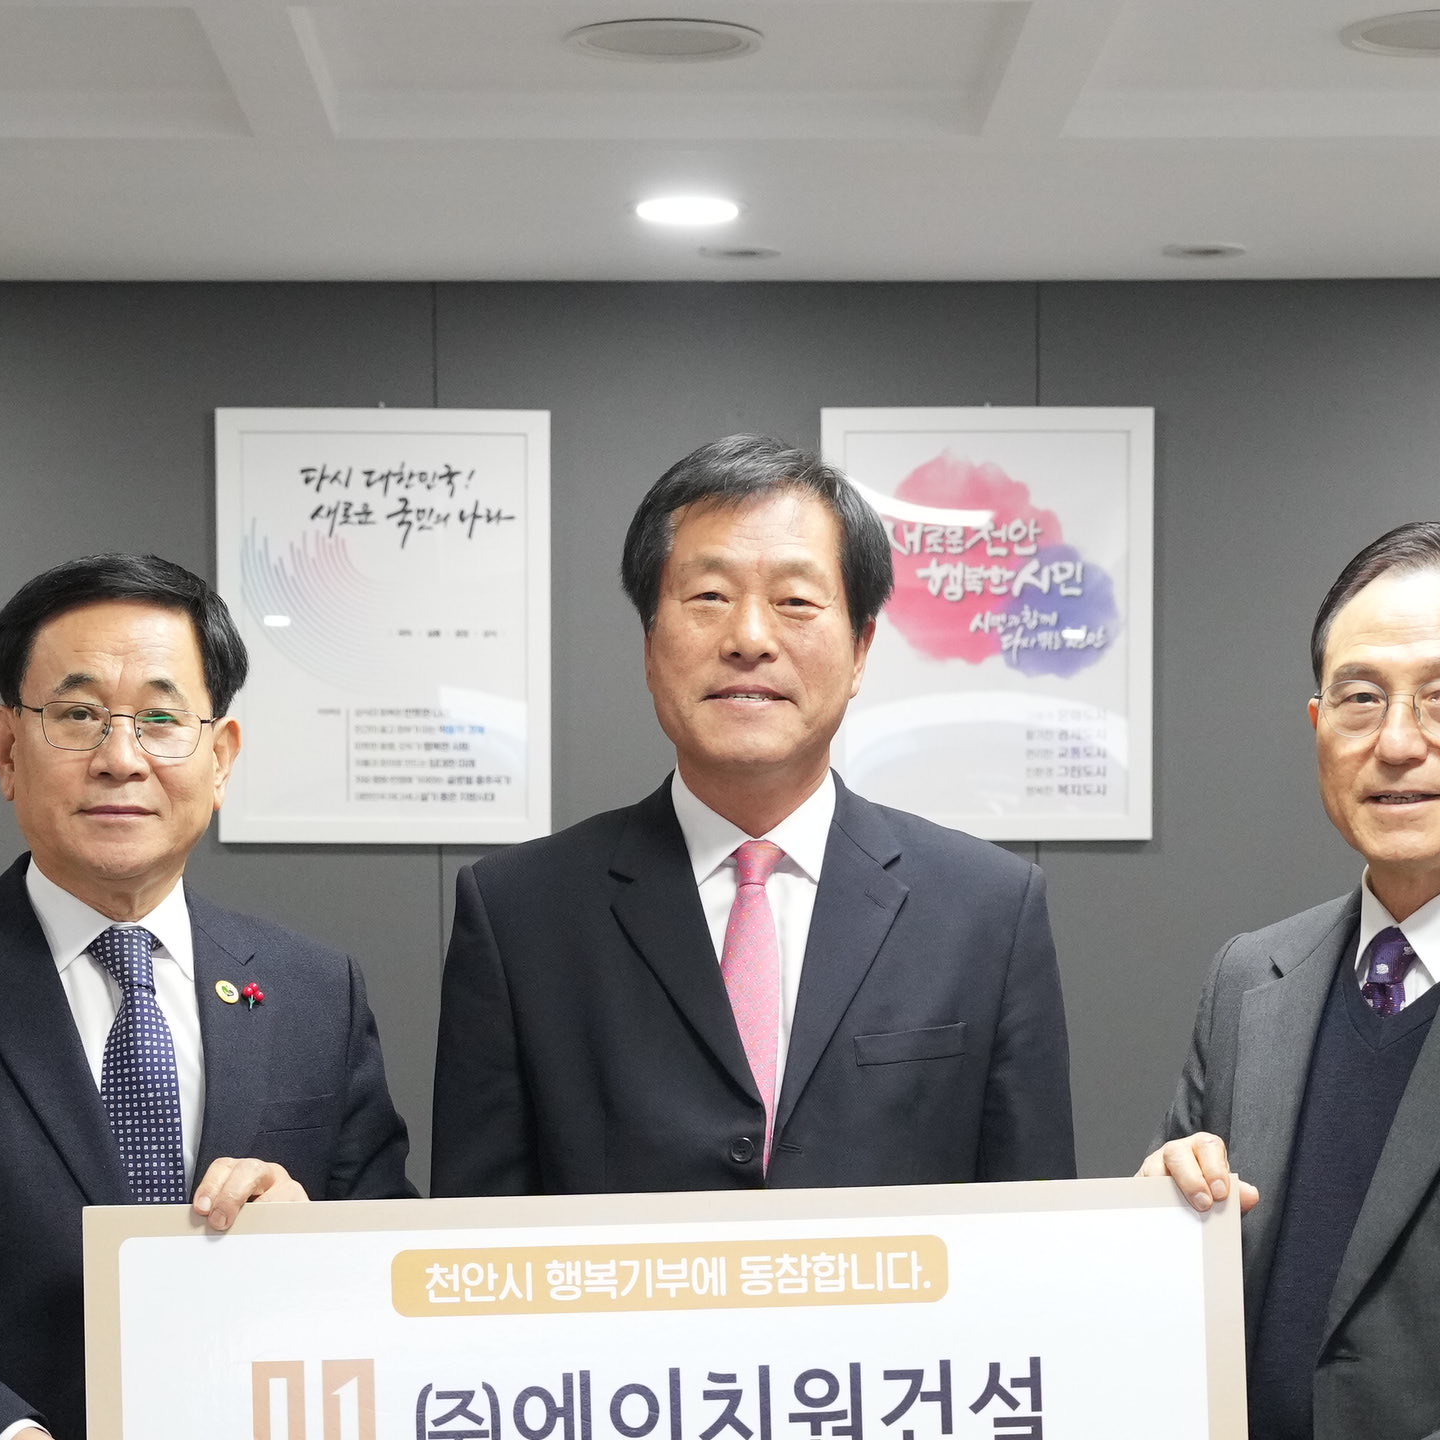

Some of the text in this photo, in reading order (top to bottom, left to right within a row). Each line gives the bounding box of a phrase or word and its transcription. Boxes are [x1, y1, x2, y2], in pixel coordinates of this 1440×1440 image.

[300, 461, 475, 498] 다시 대한민국!
[310, 497, 515, 549] 새로운 국민의 나라
[966, 517, 1043, 557] 천안
[916, 558, 1084, 602] 행복한 시민
[424, 1250, 933, 1304] 천안시 행복기부에 동참합니다.
